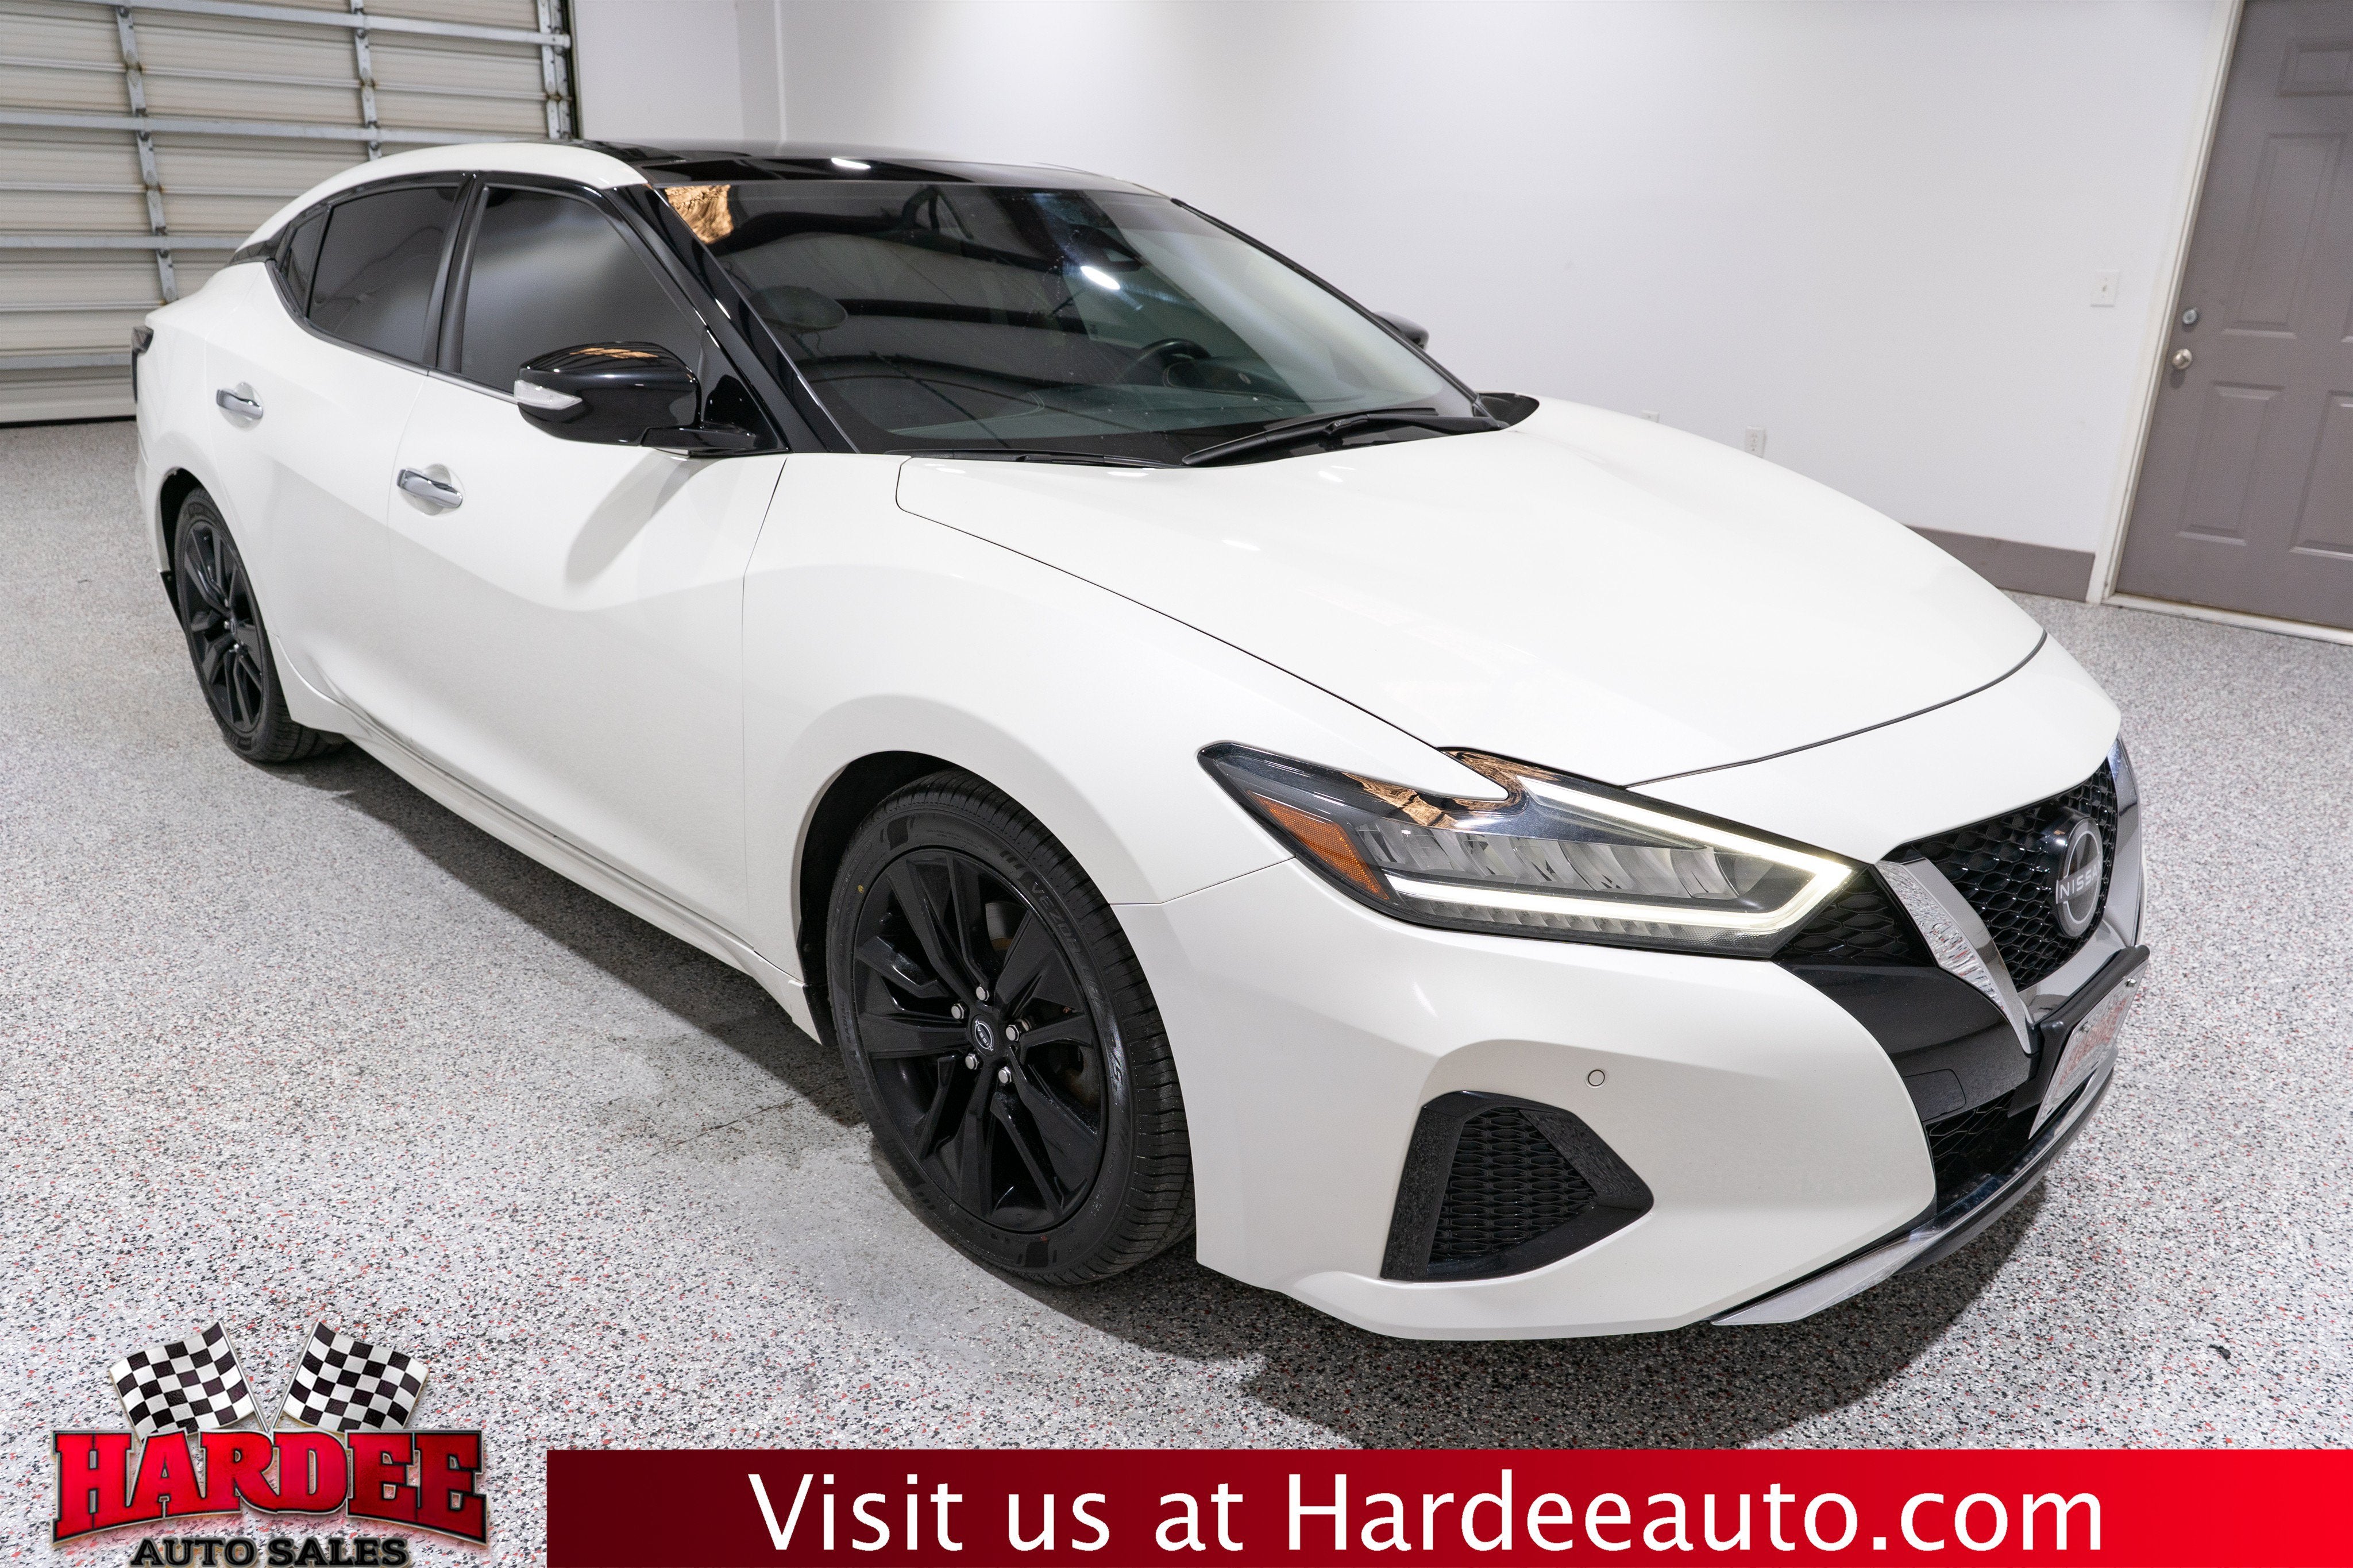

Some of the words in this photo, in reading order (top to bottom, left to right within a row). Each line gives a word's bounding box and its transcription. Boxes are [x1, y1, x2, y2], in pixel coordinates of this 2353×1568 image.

[2059, 860, 2102, 899] NISSAN
[1032, 881, 1081, 955] VEZDA
[839, 1001, 852, 1044] RADIAL
[975, 1019, 994, 1051] NISSAN
[847, 1050, 884, 1130] KENDA
